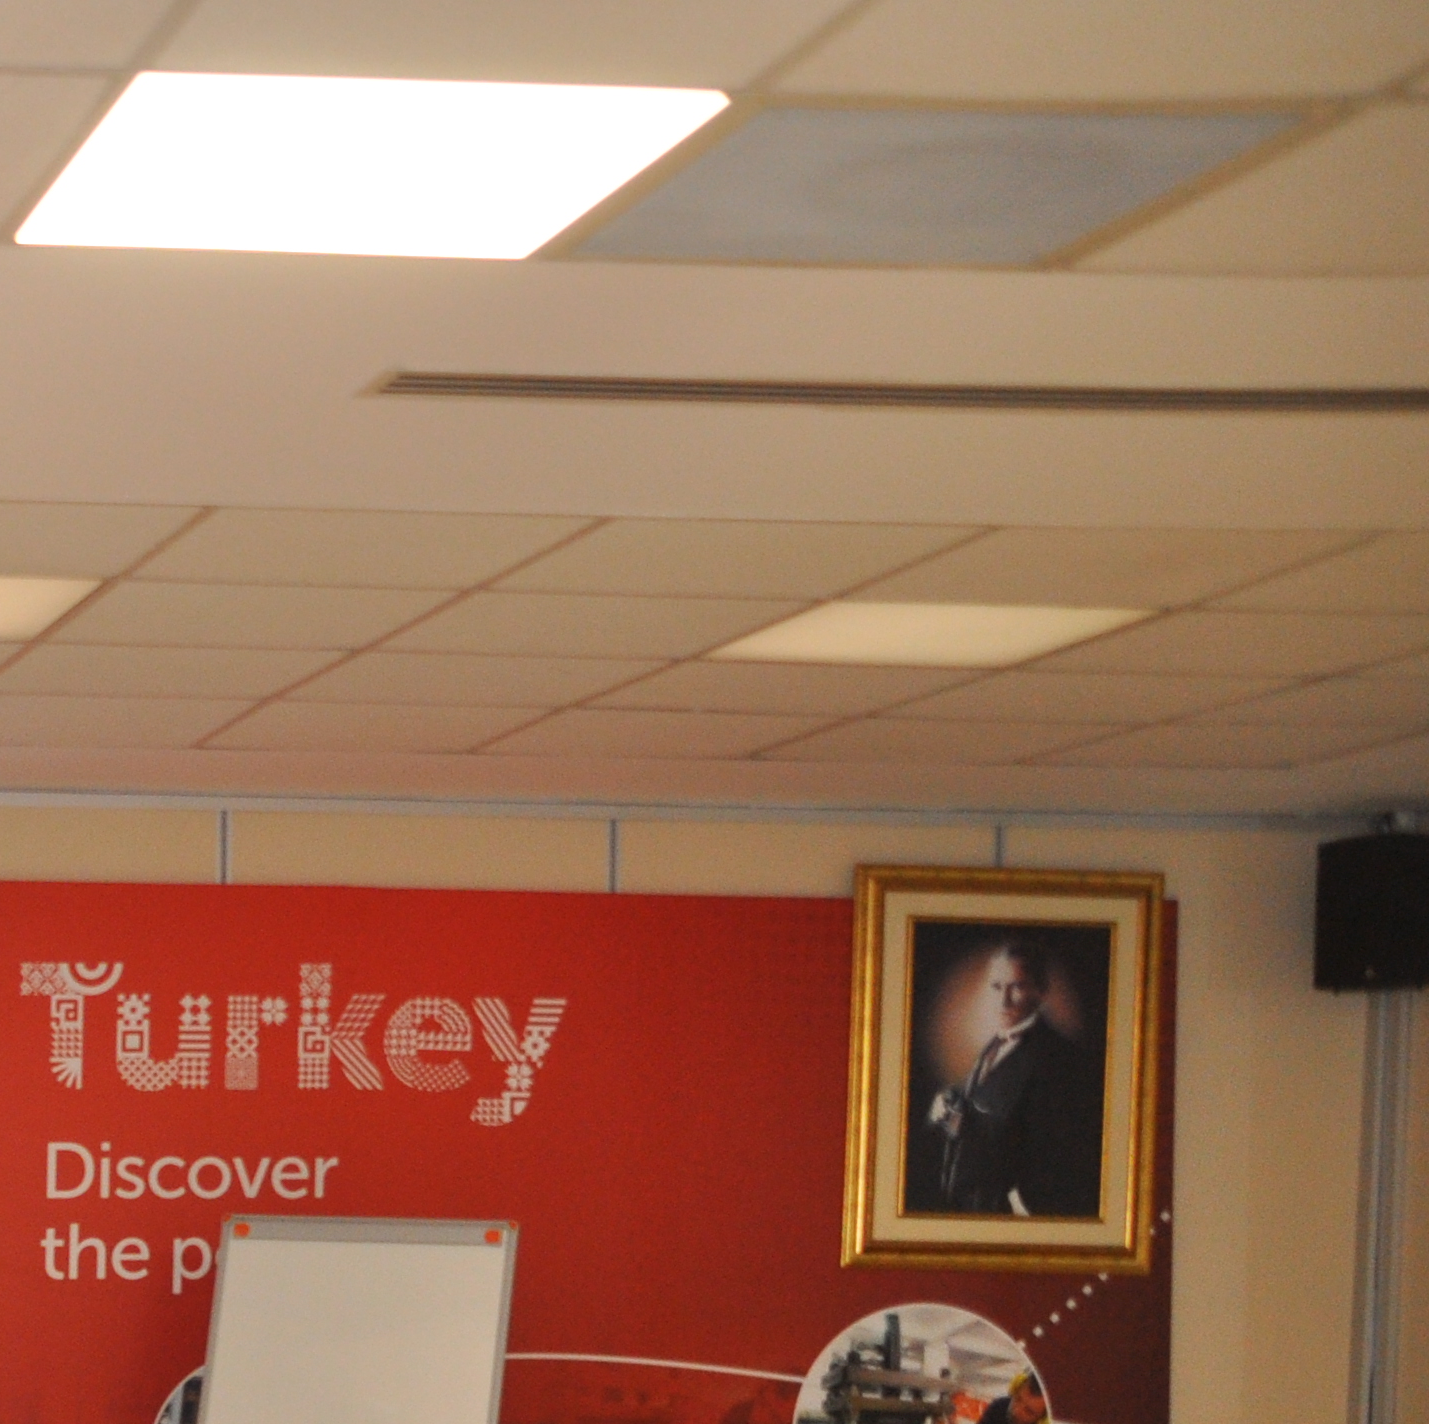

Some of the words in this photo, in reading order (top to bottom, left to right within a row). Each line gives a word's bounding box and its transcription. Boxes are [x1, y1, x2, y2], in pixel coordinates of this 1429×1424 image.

[20, 962, 568, 1127] Turkey
[46, 1141, 339, 1200] Discover
[41, 1222, 150, 1281] the
